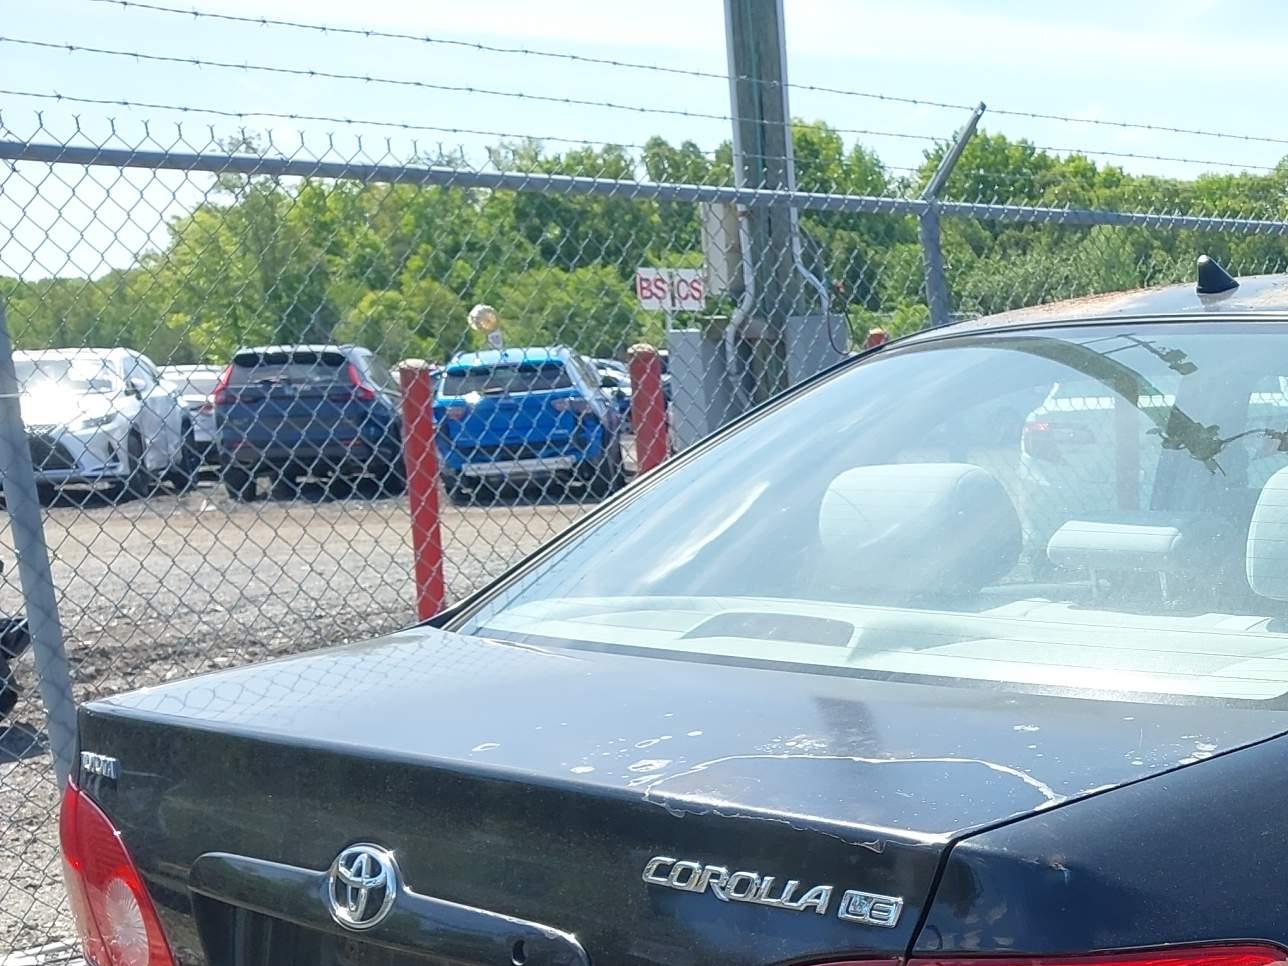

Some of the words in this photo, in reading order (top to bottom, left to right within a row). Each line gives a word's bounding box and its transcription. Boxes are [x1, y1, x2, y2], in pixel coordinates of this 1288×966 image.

[639, 277, 667, 301] BS
[677, 278, 704, 301] CS
[642, 856, 834, 914] COROLLA
[839, 889, 903, 928] LE
